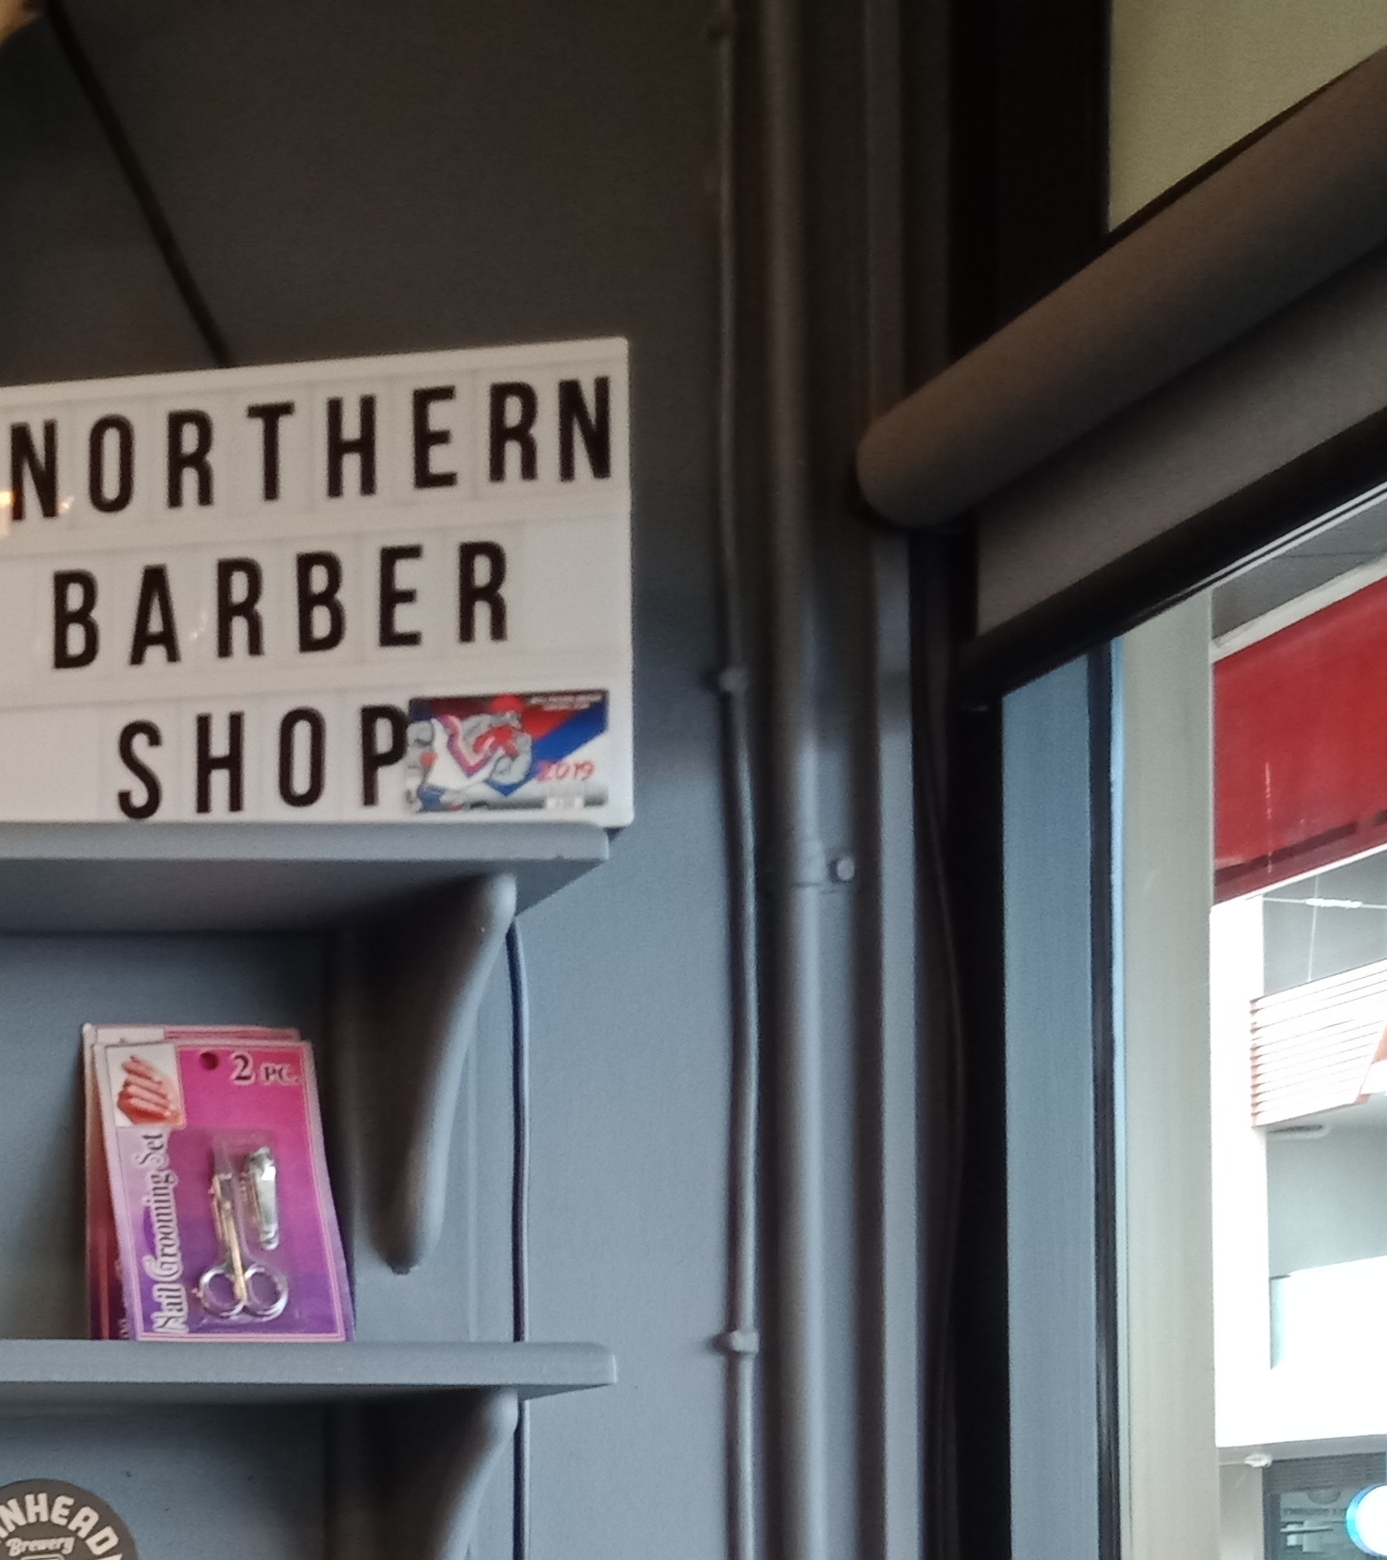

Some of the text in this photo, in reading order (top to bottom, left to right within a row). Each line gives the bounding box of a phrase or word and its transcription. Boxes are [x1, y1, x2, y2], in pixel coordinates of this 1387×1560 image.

[52, 541, 508, 669] BARBER
[118, 703, 411, 819] SHOP
[229, 1051, 257, 1084] 2
[5, 1535, 75, 1557] Brewery
